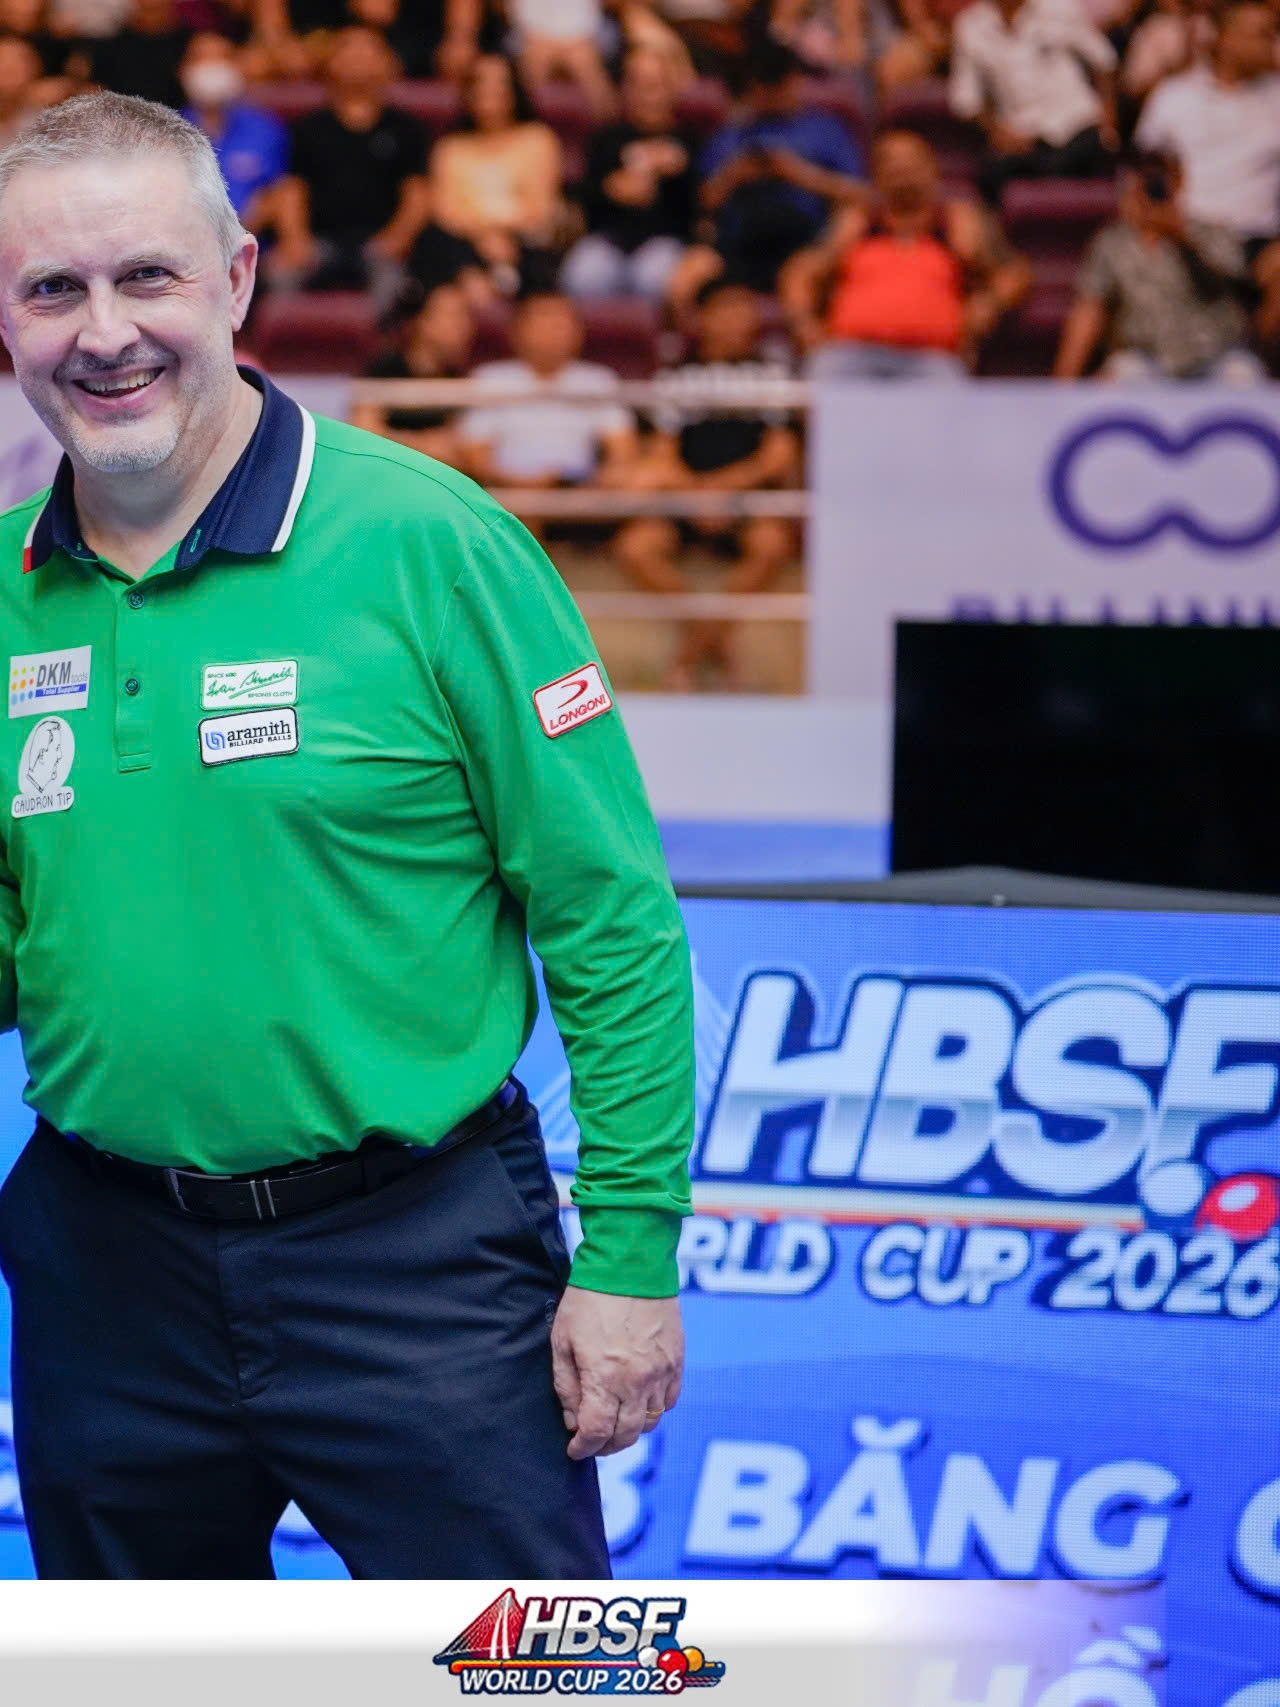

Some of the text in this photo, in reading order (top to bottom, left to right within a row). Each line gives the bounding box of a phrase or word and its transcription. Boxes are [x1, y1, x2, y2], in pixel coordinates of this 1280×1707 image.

[36, 661, 72, 688] DKM
[549, 694, 607, 731] LONGONI
[227, 720, 292, 742] aramith
[229, 737, 264, 748] BILLIARD
[14, 792, 73, 814] CAUDRON TIP
[702, 975, 1280, 1196] HBSF
[861, 1222, 1030, 1305] CUP
[1049, 1226, 1280, 1320] 2026
[685, 1416, 1180, 1580] BĂNG
